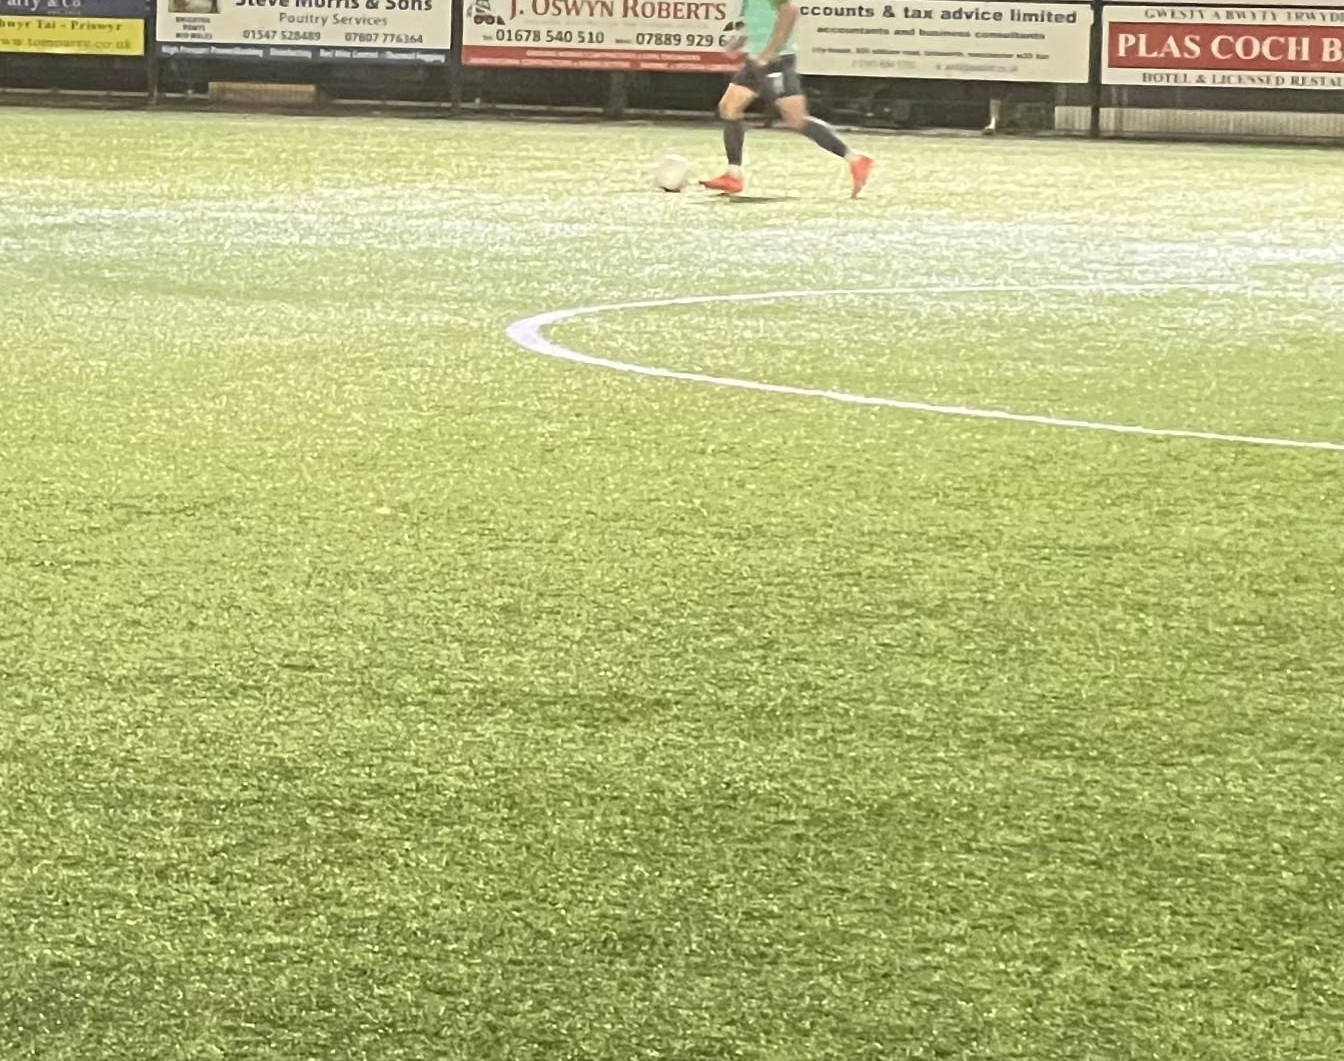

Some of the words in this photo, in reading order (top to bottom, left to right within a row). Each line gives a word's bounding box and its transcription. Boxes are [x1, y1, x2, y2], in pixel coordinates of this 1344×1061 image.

[279, 12, 328, 27] Poultry
[333, 13, 388, 27] Services
[799, 5, 875, 18] ccounts
[882, 5, 896, 18] &
[903, 6, 933, 20] tax
[941, 8, 1003, 22] advice
[1010, 9, 1077, 24] limited
[495, 28, 541, 42] 01678
[546, 30, 573, 43] 540
[577, 31, 604, 44] 510
[635, 32, 681, 46] 07889
[686, 33, 716, 47] 929
[1117, 33, 1201, 59] PLAS
[1210, 35, 1310, 61] COCH
[1321, 37, 1344, 63] B
[1142, 72, 1188, 84] HOTEL
